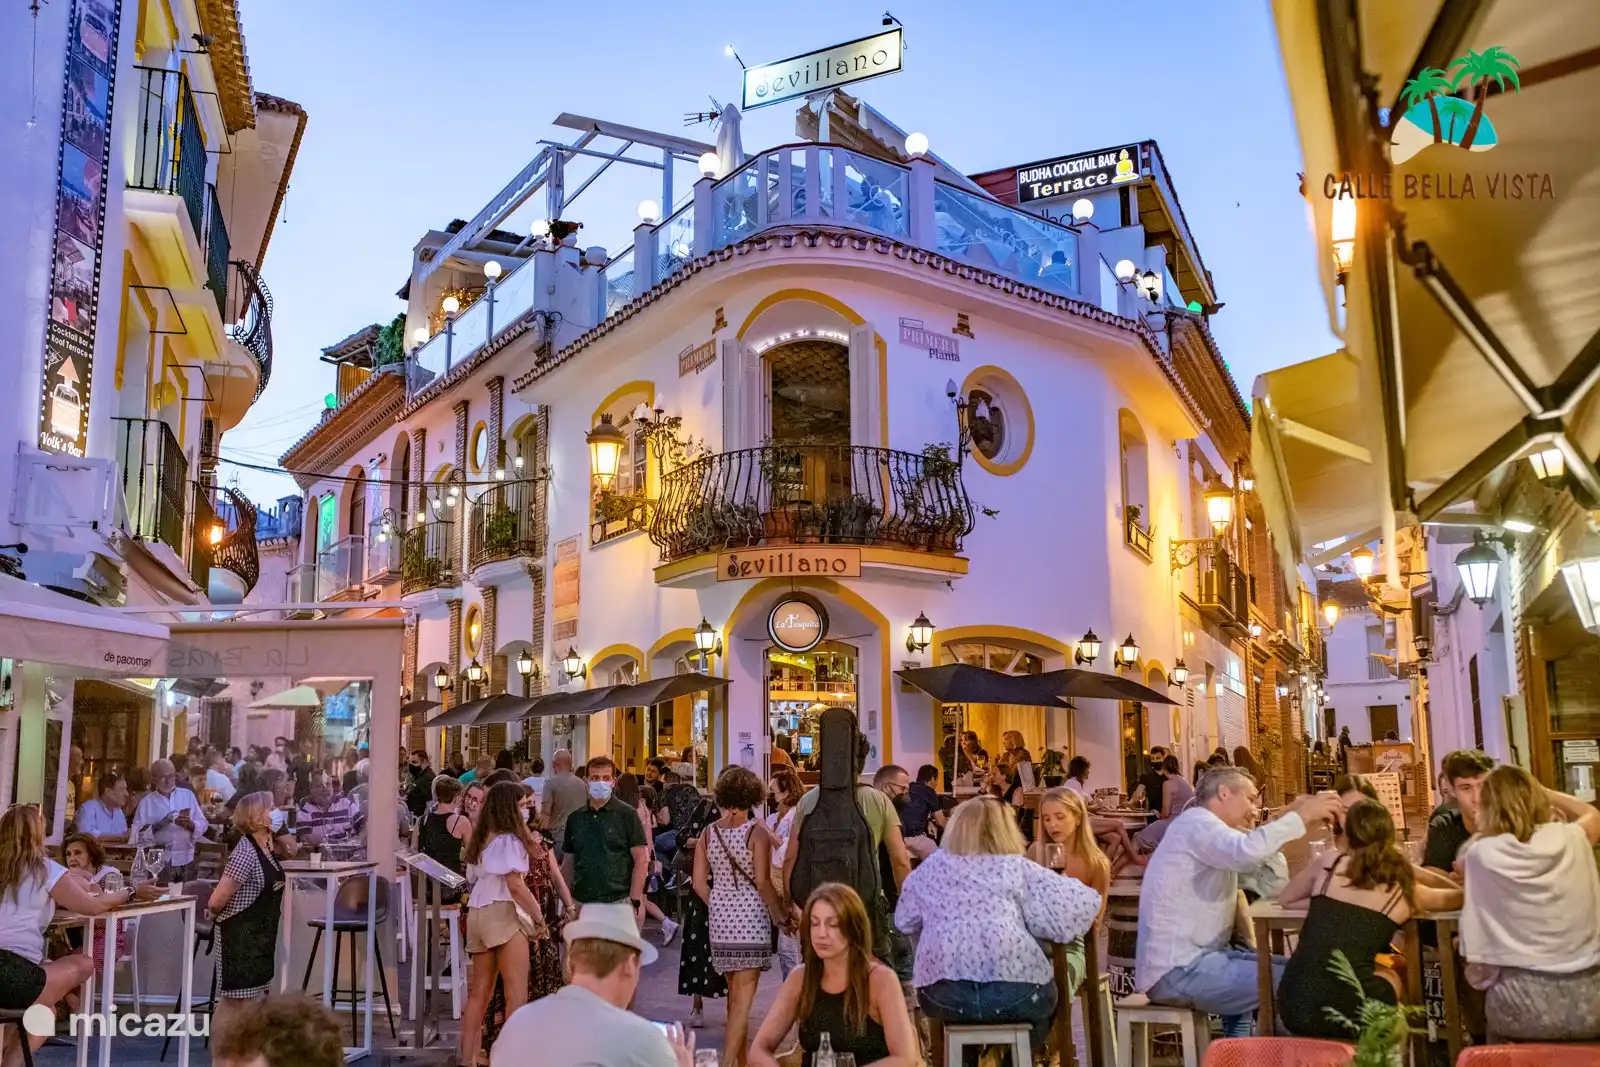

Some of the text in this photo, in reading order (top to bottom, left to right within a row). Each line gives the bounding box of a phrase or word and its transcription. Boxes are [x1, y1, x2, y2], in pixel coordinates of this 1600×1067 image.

[755, 49, 888, 98] Sevillano
[1019, 153, 1117, 184] BUDHA COCKTAIL BAR
[1029, 172, 1108, 198] Terrace
[51, 323, 89, 347] Cocktail Bar
[51, 333, 88, 358] Roof Terrace
[928, 347, 961, 362] Planta
[40, 431, 84, 458] Volk's Bar
[727, 552, 848, 577] Sevillano
[103, 651, 115, 663] de
